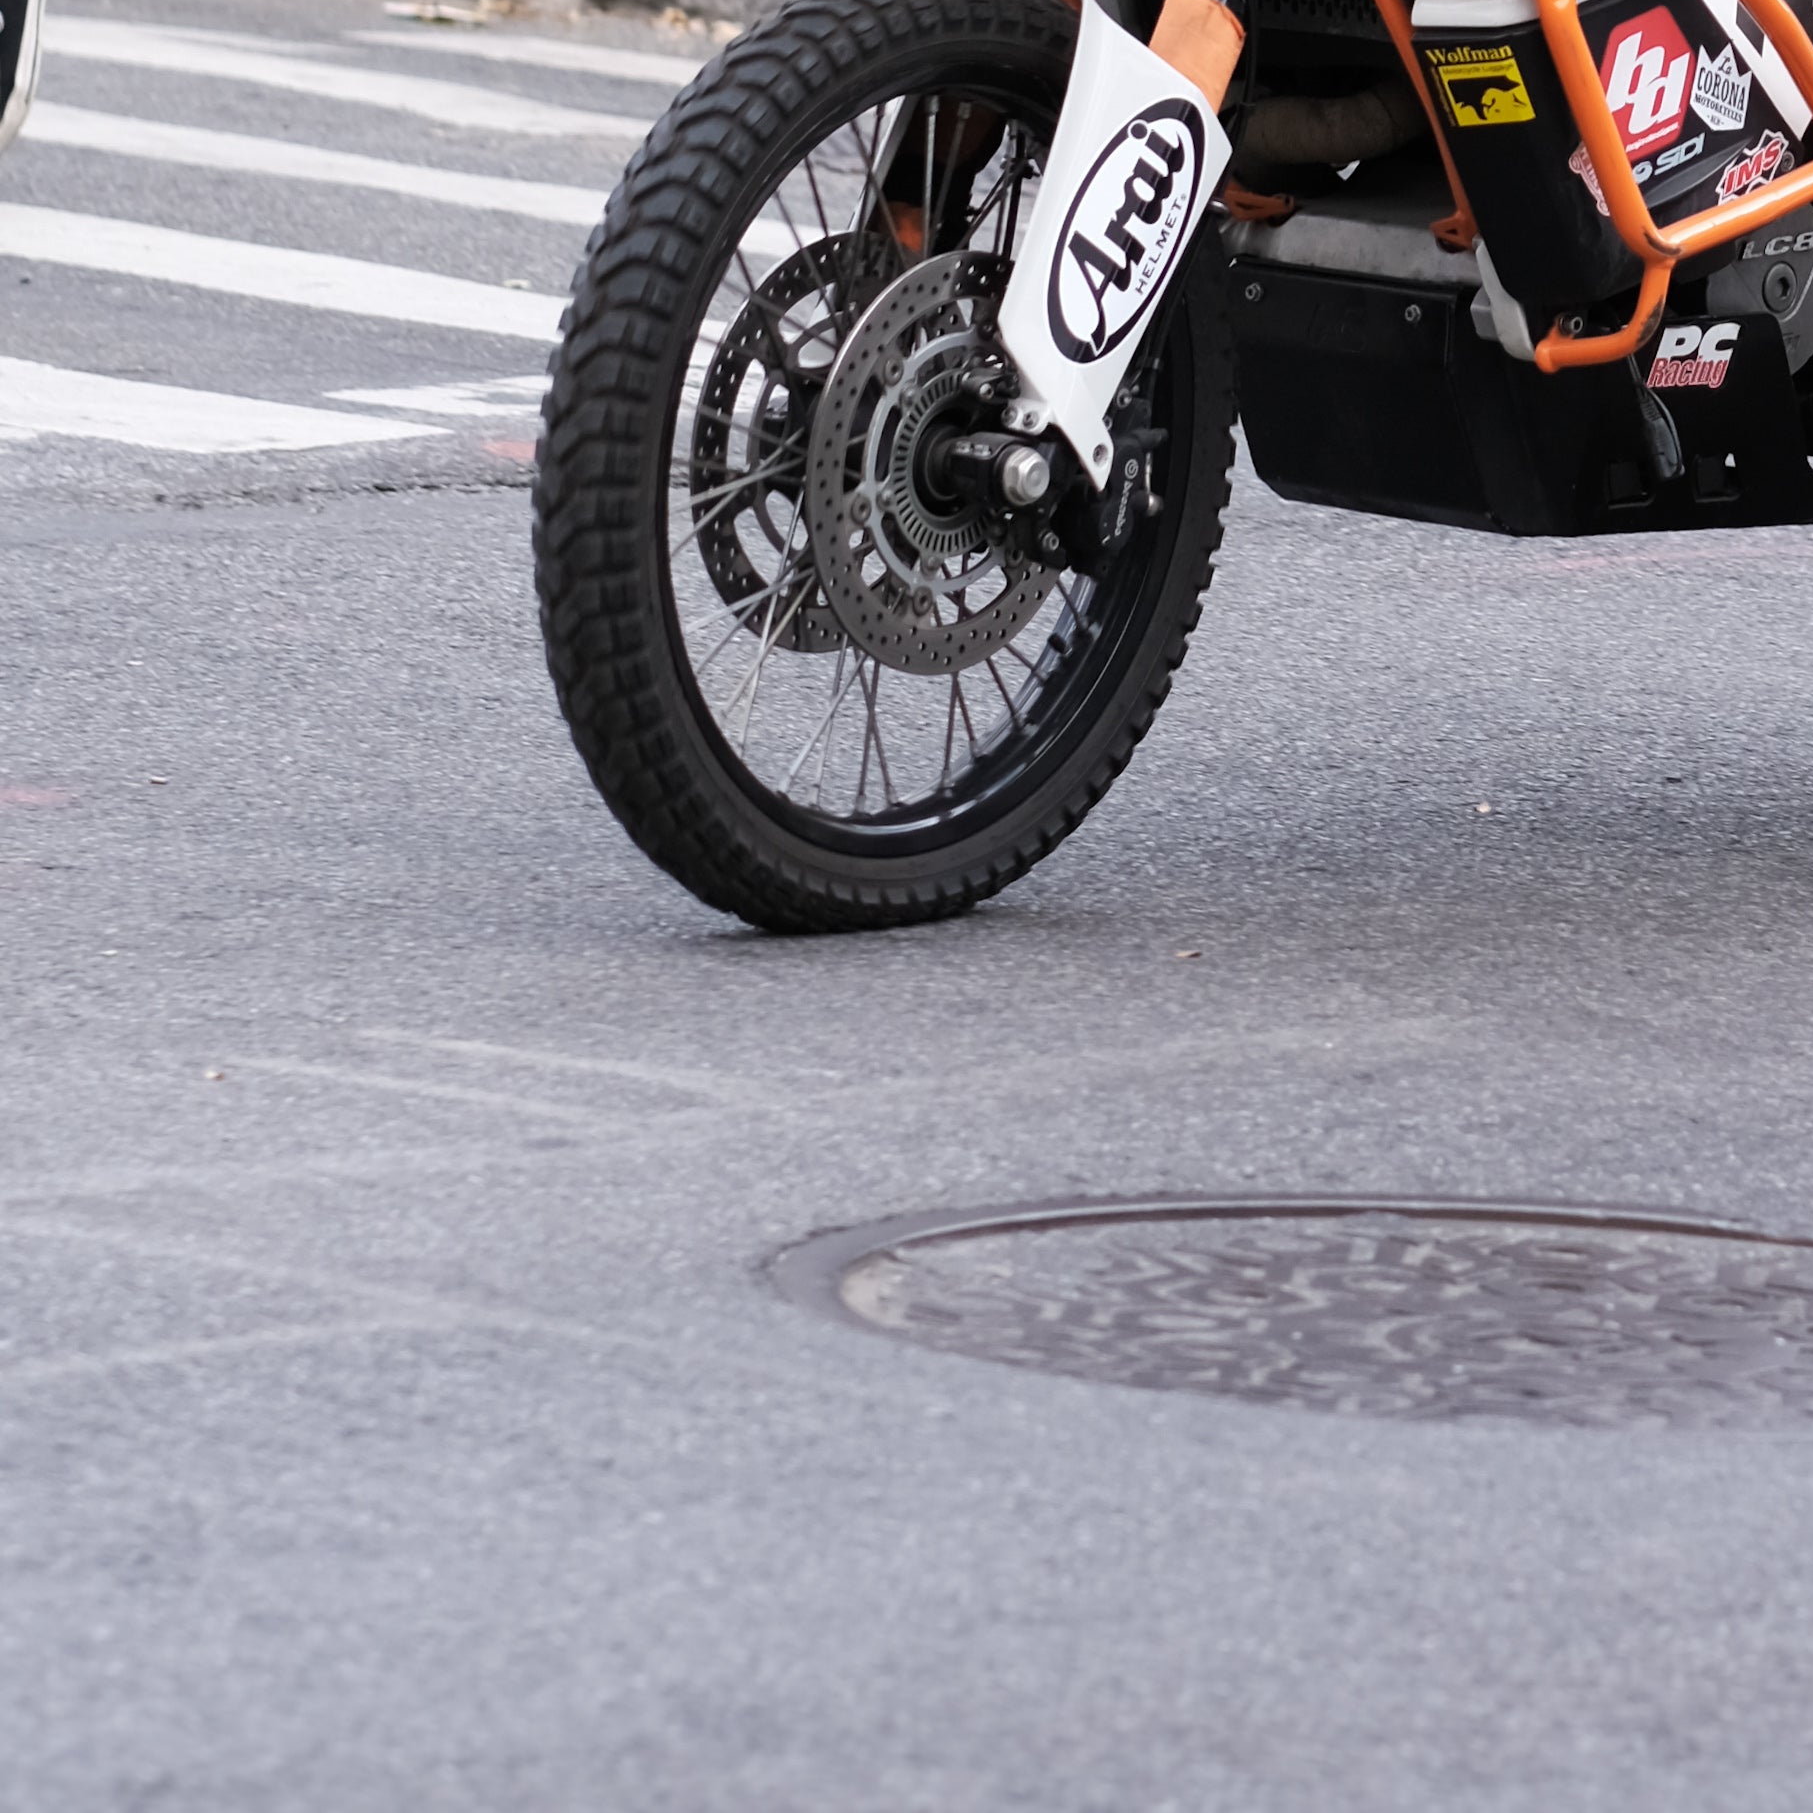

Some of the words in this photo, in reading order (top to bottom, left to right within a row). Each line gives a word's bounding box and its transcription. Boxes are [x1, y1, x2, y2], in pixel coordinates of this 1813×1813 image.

[1425, 44, 1514, 64] Wolfman
[1694, 93, 1743, 124] MOTORCYCLES
[1697, 67, 1746, 112] CORONA
[1723, 137, 1783, 197] IMS
[1068, 122, 1186, 354] Arai
[1134, 199, 1184, 296] HELMET
[1655, 321, 1742, 362] PC
[1646, 357, 1730, 389] Racing
